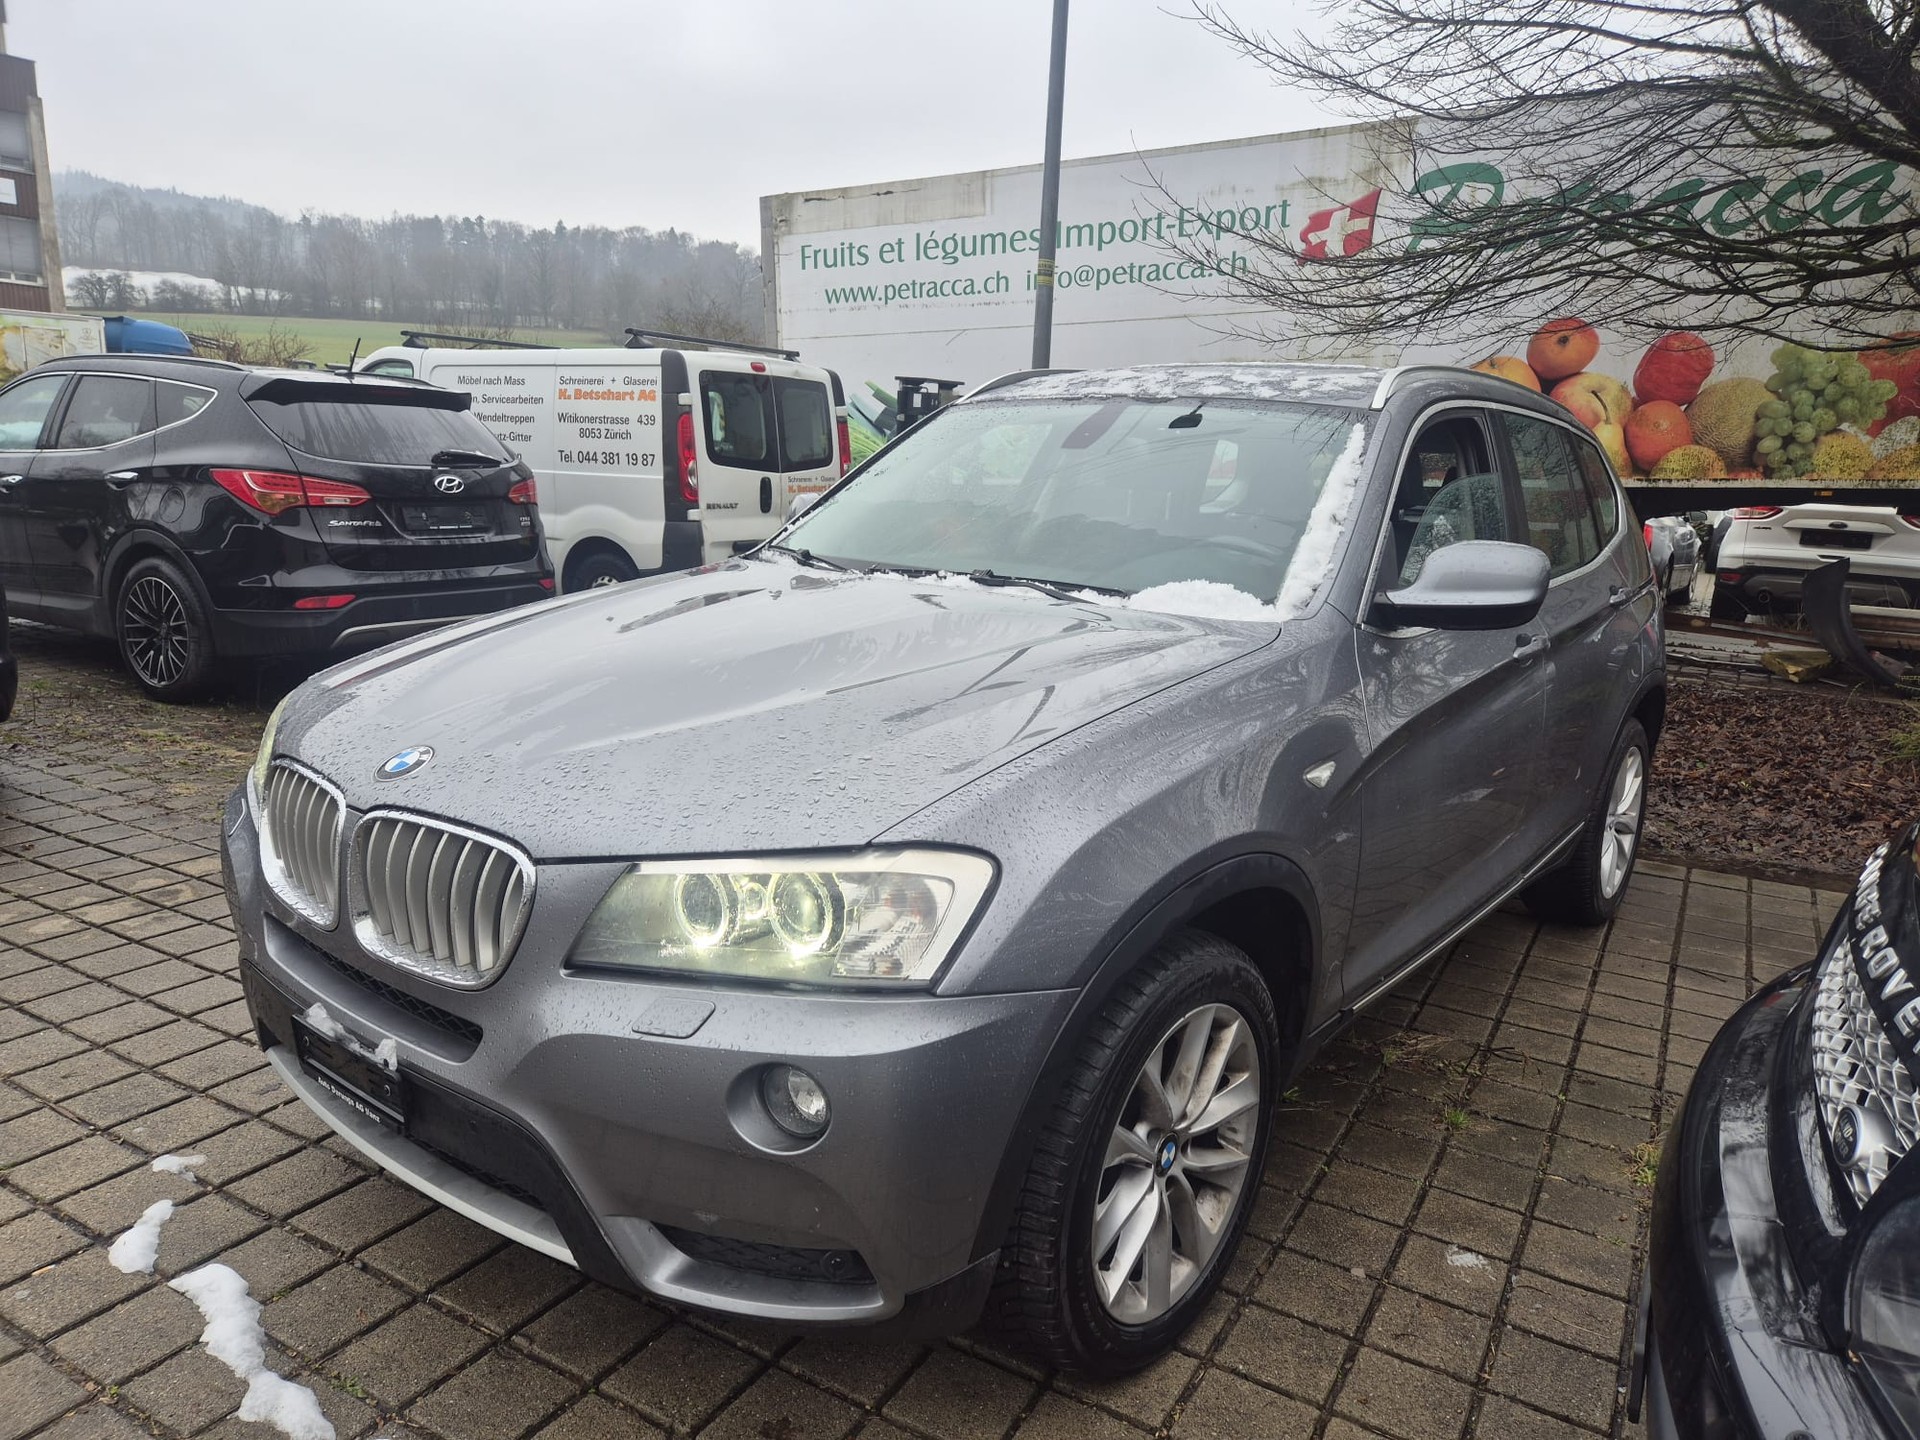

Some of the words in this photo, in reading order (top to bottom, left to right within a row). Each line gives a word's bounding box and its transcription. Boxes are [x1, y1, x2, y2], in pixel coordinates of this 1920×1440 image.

[800, 242, 870, 270] Fruits
[878, 238, 905, 264] et
[915, 230, 1040, 265] légumes
[1056, 199, 1291, 251] Import-Export
[825, 270, 1009, 304] www.petracca.ch
[1026, 250, 1248, 291] io@petracca.ch
[457, 375, 482, 385] Möbel
[483, 376, 502, 385] nach
[503, 376, 526, 386] Mass
[559, 376, 604, 385] Schreinerei
[623, 376, 657, 386] Glaserei
[481, 394, 544, 405] Servicearbeiten
[573, 388, 635, 401] Betschart
[637, 389, 656, 402] AG
[474, 412, 535, 425] Wendeltreppen
[557, 412, 630, 425] Witikonerstrasse
[637, 414, 656, 426] 439
[579, 427, 602, 439] 8053
[604, 428, 632, 440] Zürich
[558, 449, 575, 464] Tel.
[577, 450, 598, 464] 044
[601, 451, 620, 465] 381
[626, 452, 638, 466] 19
[641, 453, 655, 467] 87
